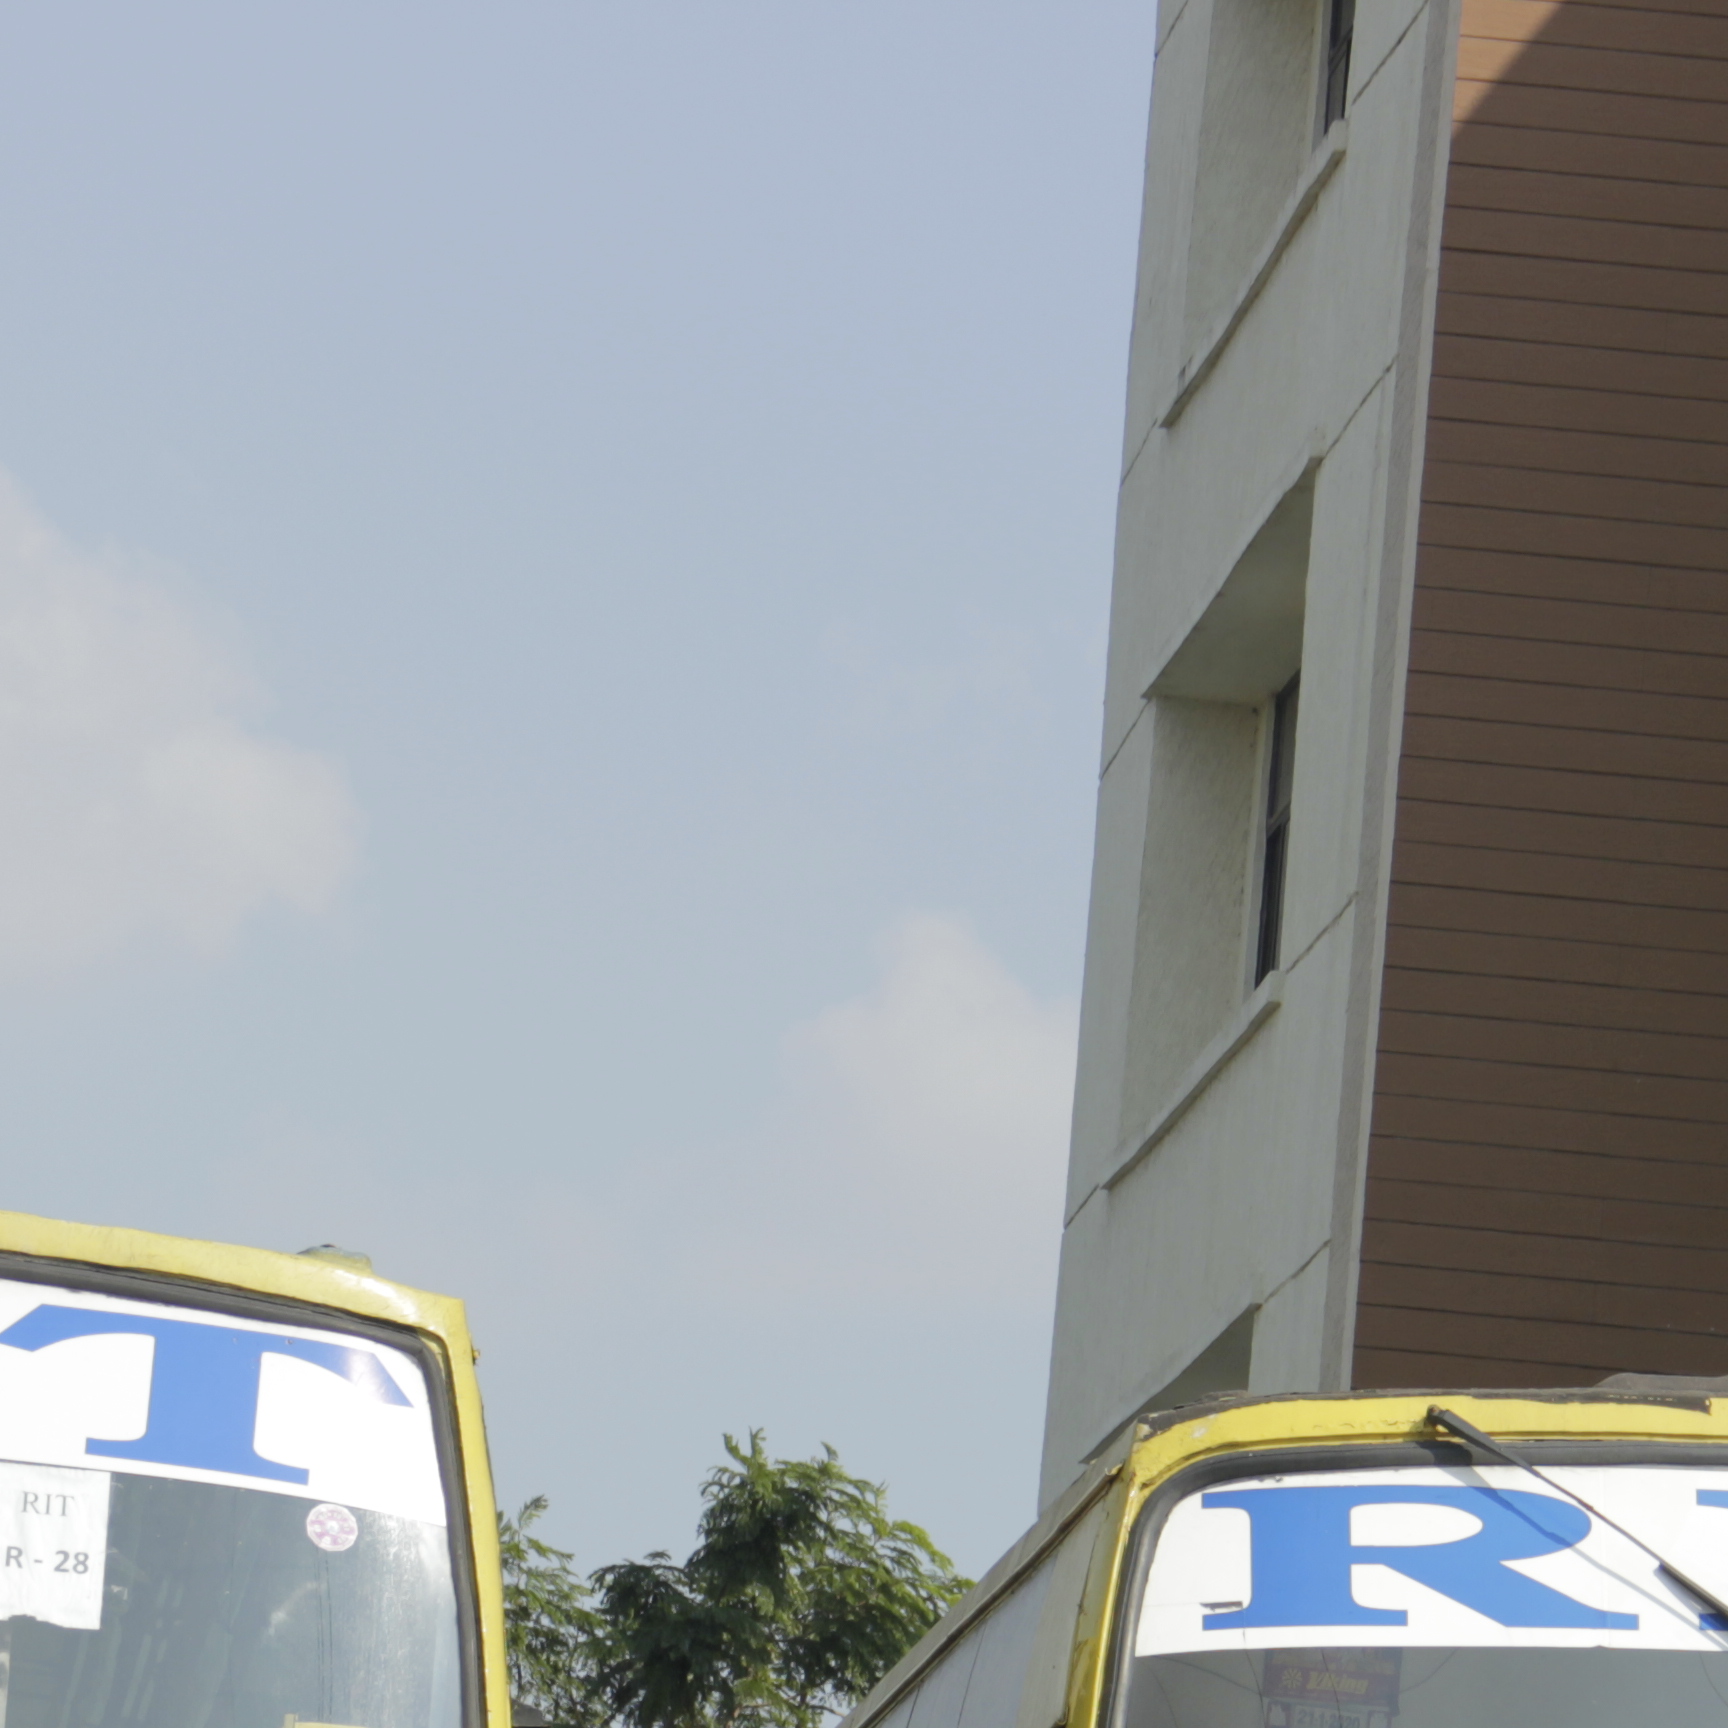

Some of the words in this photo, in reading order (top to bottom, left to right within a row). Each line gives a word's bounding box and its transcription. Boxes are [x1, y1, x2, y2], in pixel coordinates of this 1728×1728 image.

[21, 1490, 75, 1517] RIT
[5, 1545, 23, 1569] R
[53, 1550, 89, 1575] 28
